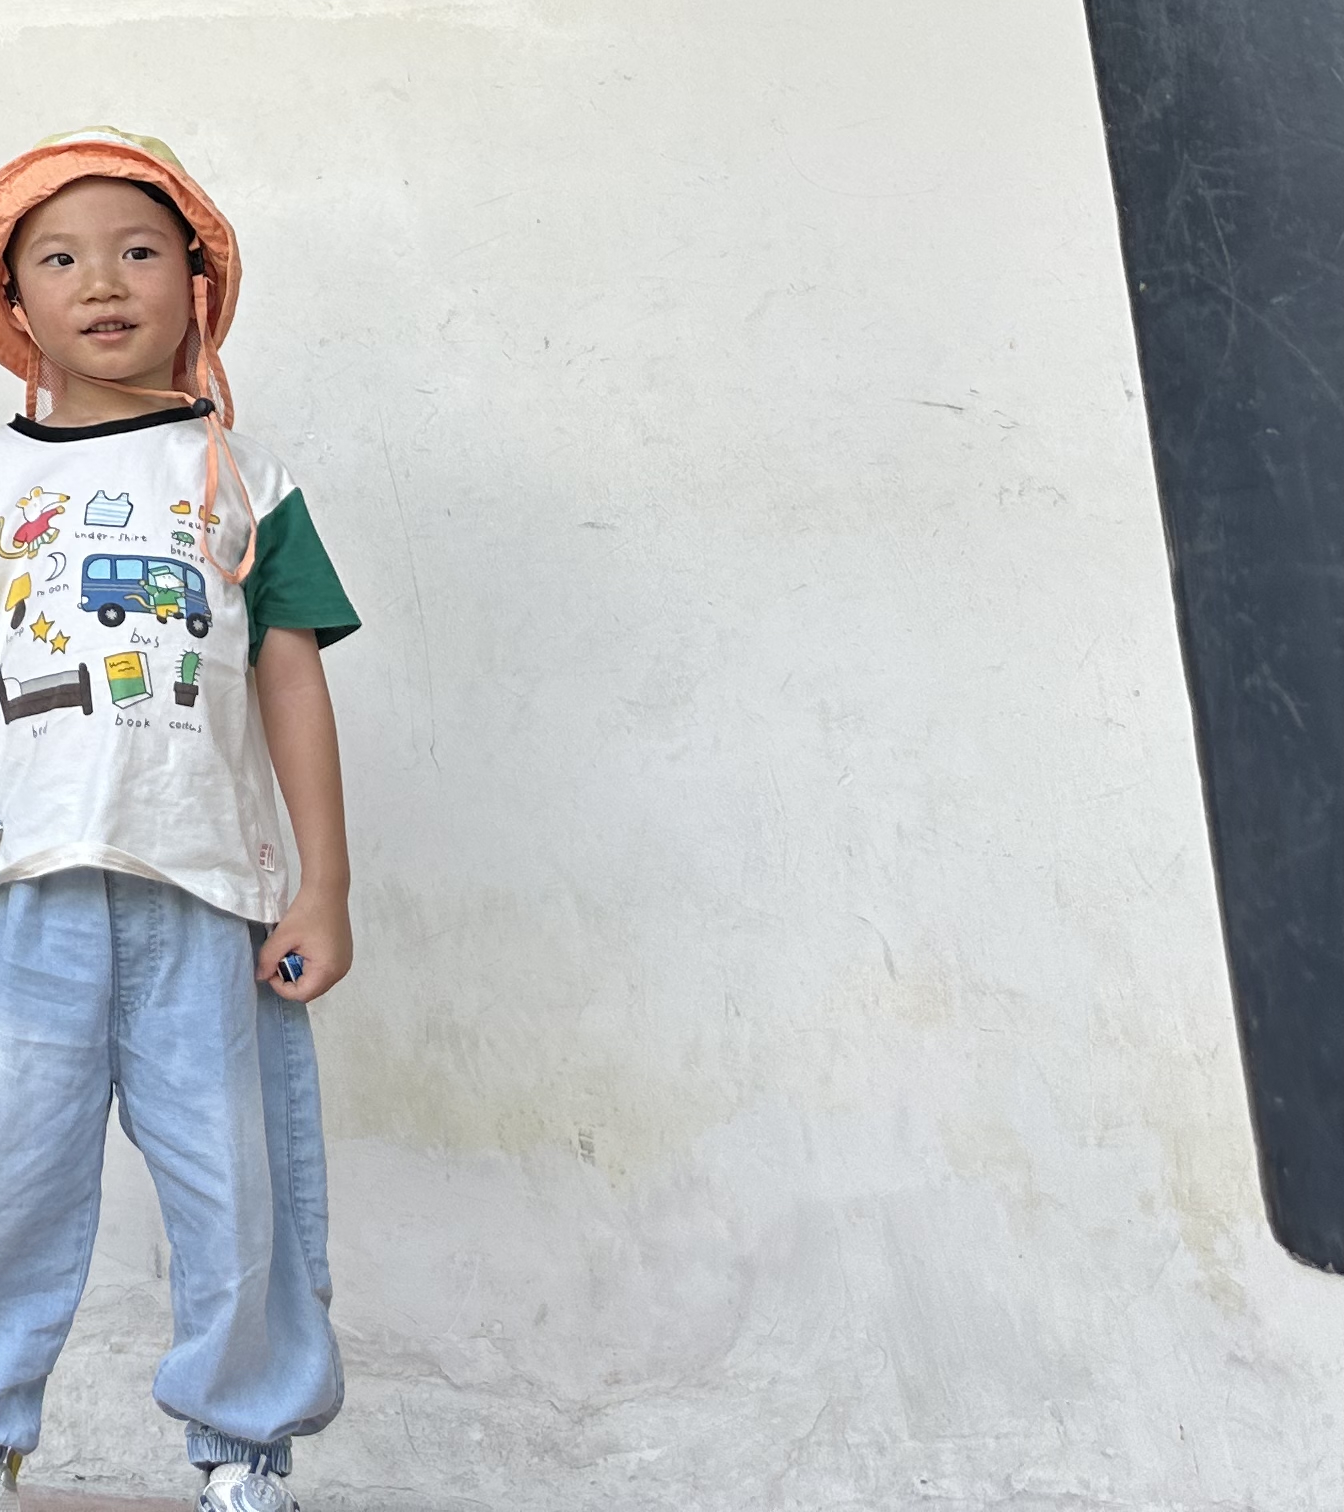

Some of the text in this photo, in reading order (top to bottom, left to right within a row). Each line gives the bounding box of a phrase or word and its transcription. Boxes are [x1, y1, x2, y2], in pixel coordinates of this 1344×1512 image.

[36, 583, 70, 597] moon
[130, 627, 160, 648] bus
[115, 713, 151, 728] book
